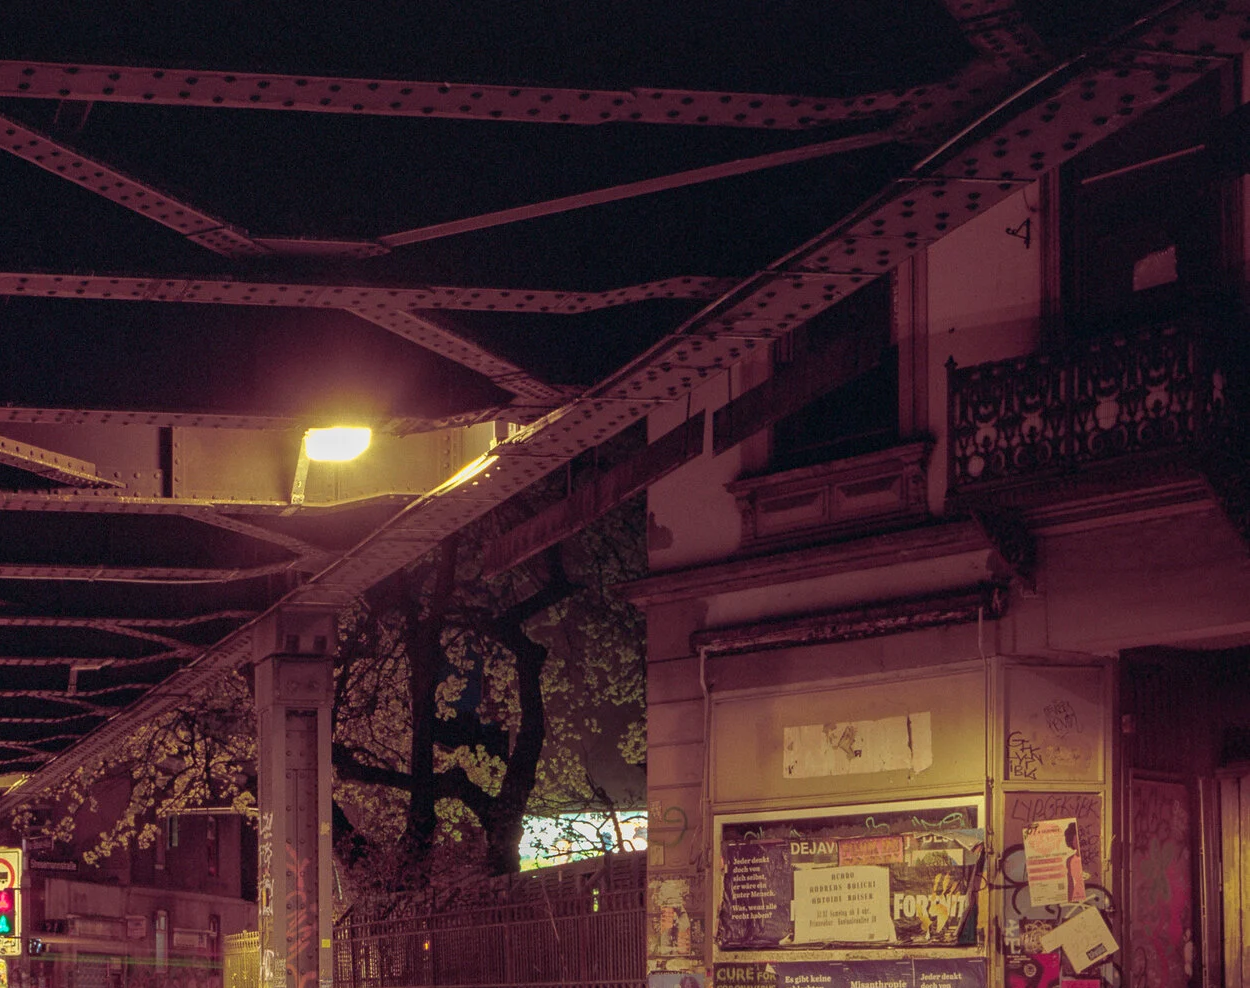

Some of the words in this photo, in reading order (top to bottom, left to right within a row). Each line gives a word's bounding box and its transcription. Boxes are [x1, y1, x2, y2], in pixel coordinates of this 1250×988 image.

[716, 967, 755, 981] CURE
[756, 970, 776, 981] FOR
[794, 976, 809, 984] gibt
[810, 974, 832, 983] keine
[941, 972, 963, 980] denkt
